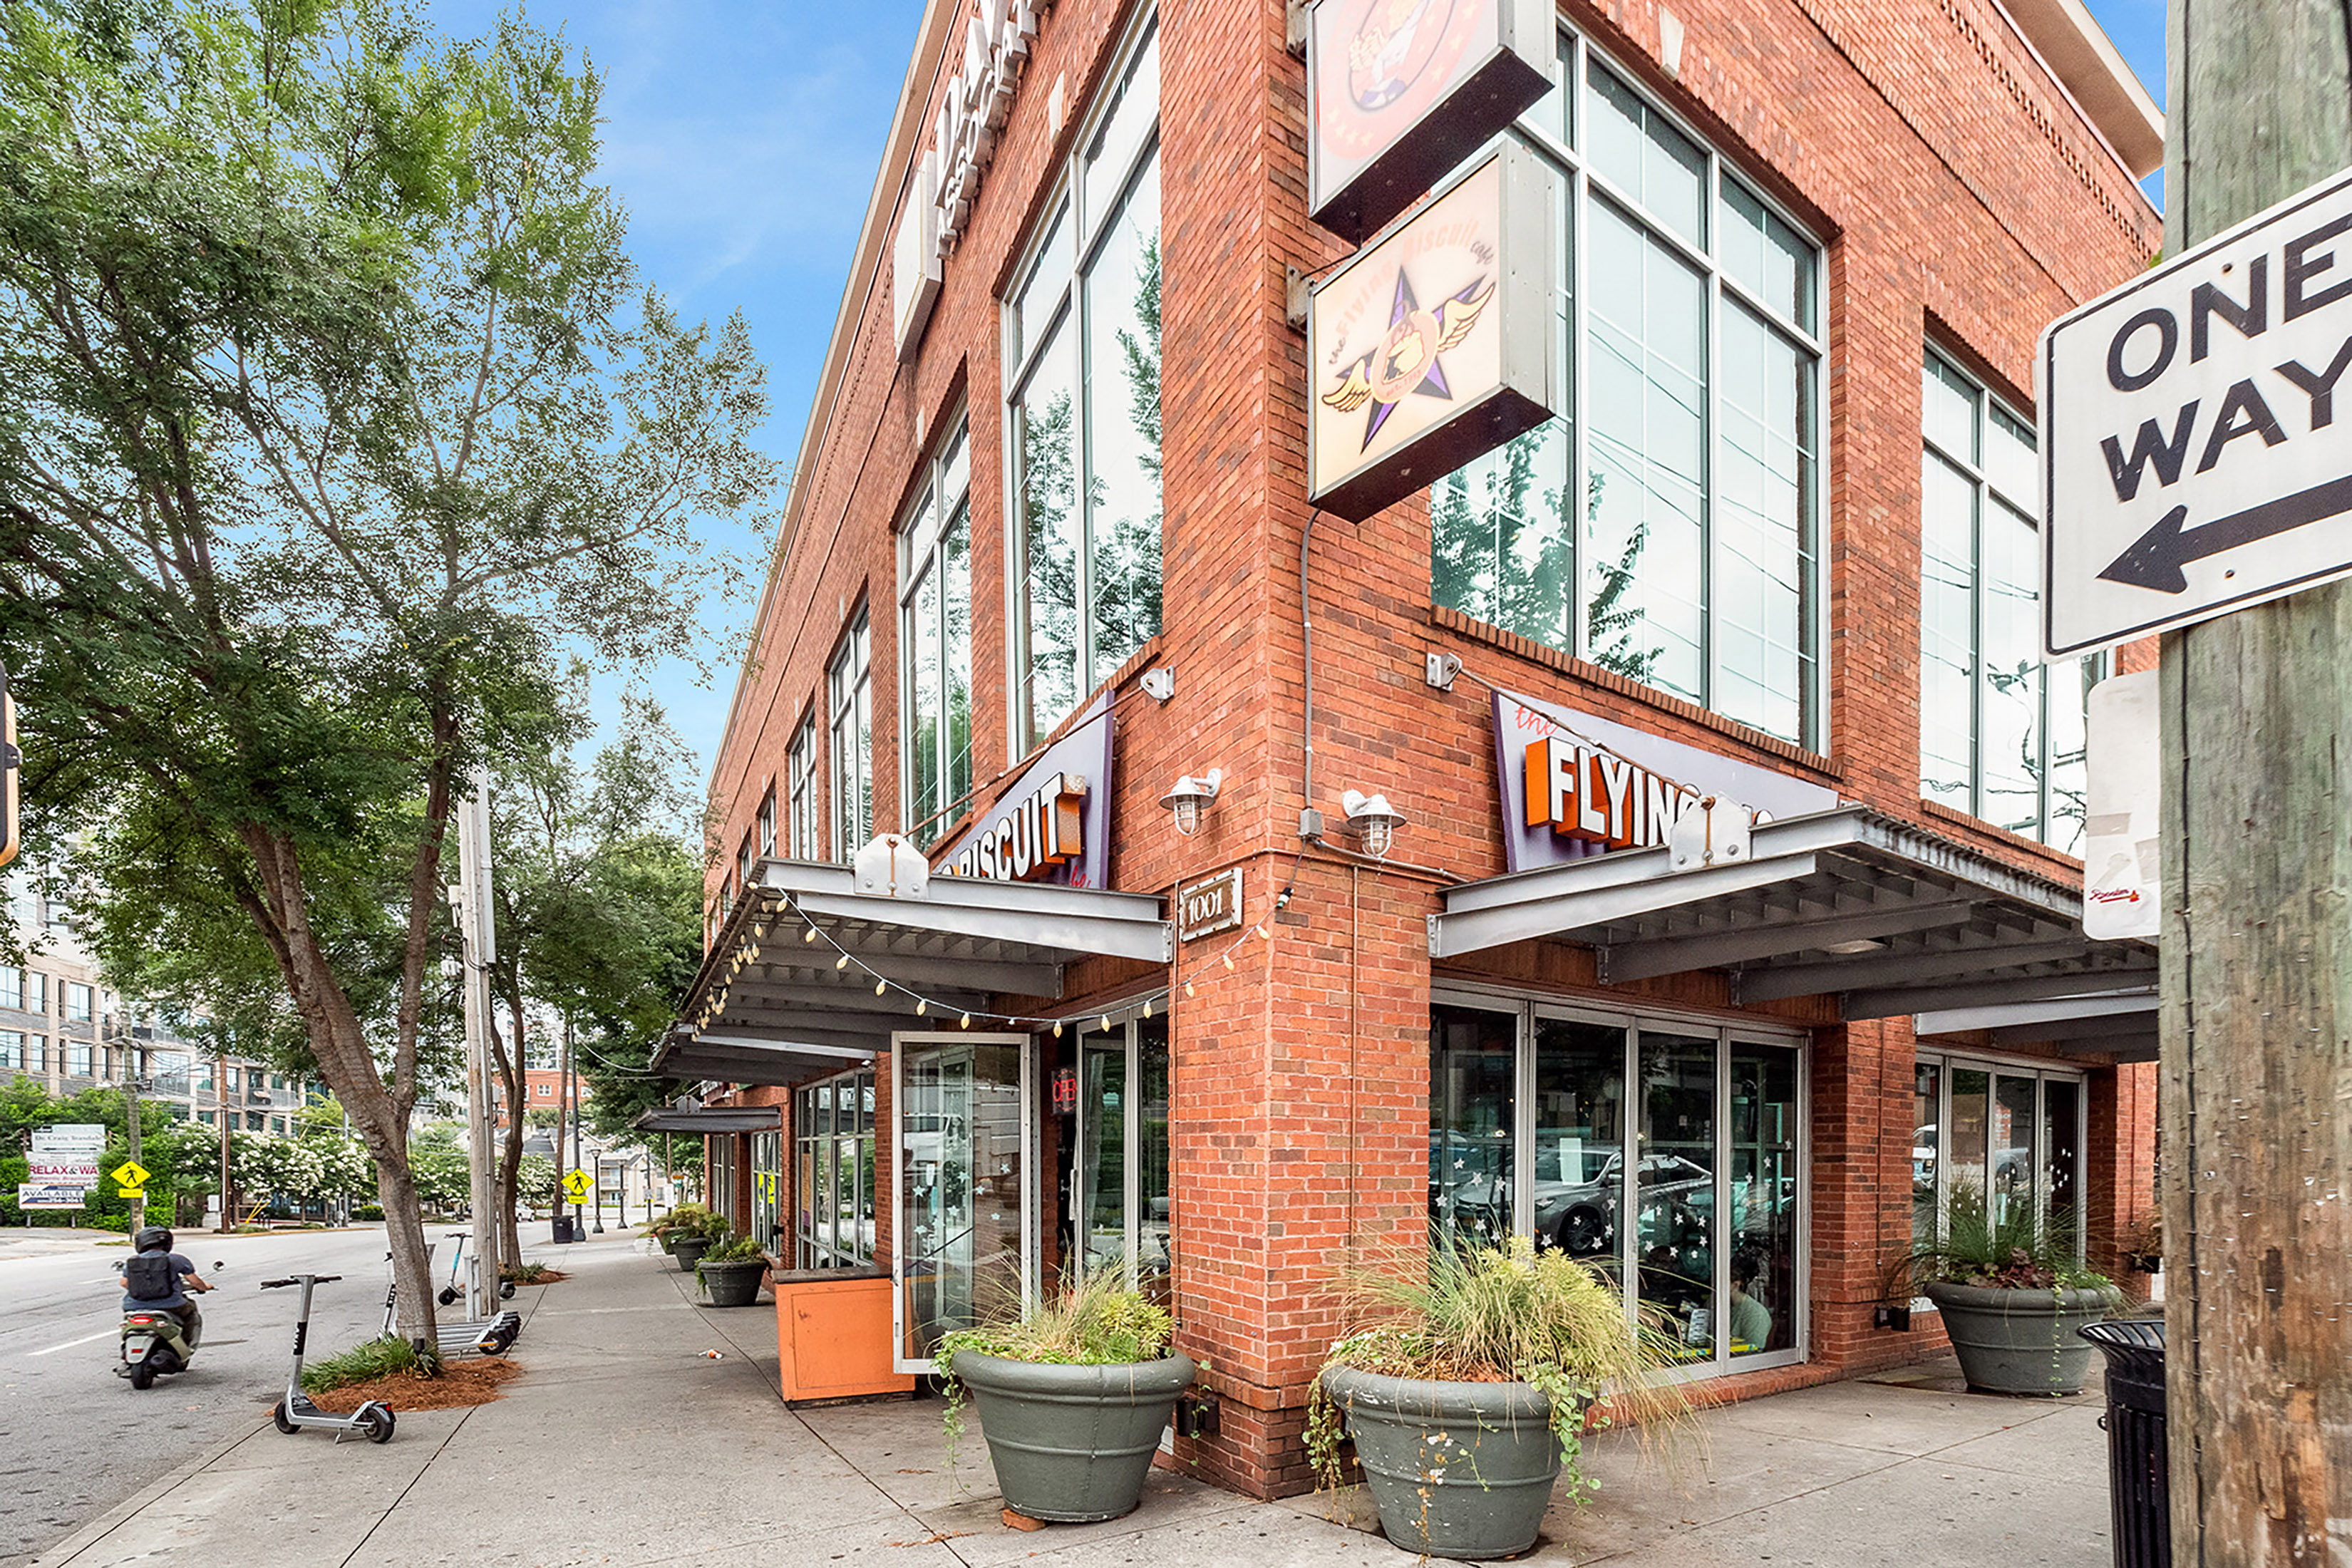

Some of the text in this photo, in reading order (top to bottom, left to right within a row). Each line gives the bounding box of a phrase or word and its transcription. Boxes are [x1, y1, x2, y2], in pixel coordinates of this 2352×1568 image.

[937, 0, 1042, 258] ASSOCIAT
[2107, 212, 2352, 393] ONE
[2100, 336, 2352, 503] WAY
[1515, 706, 1559, 736] the
[1188, 887, 1222, 926] 1001
